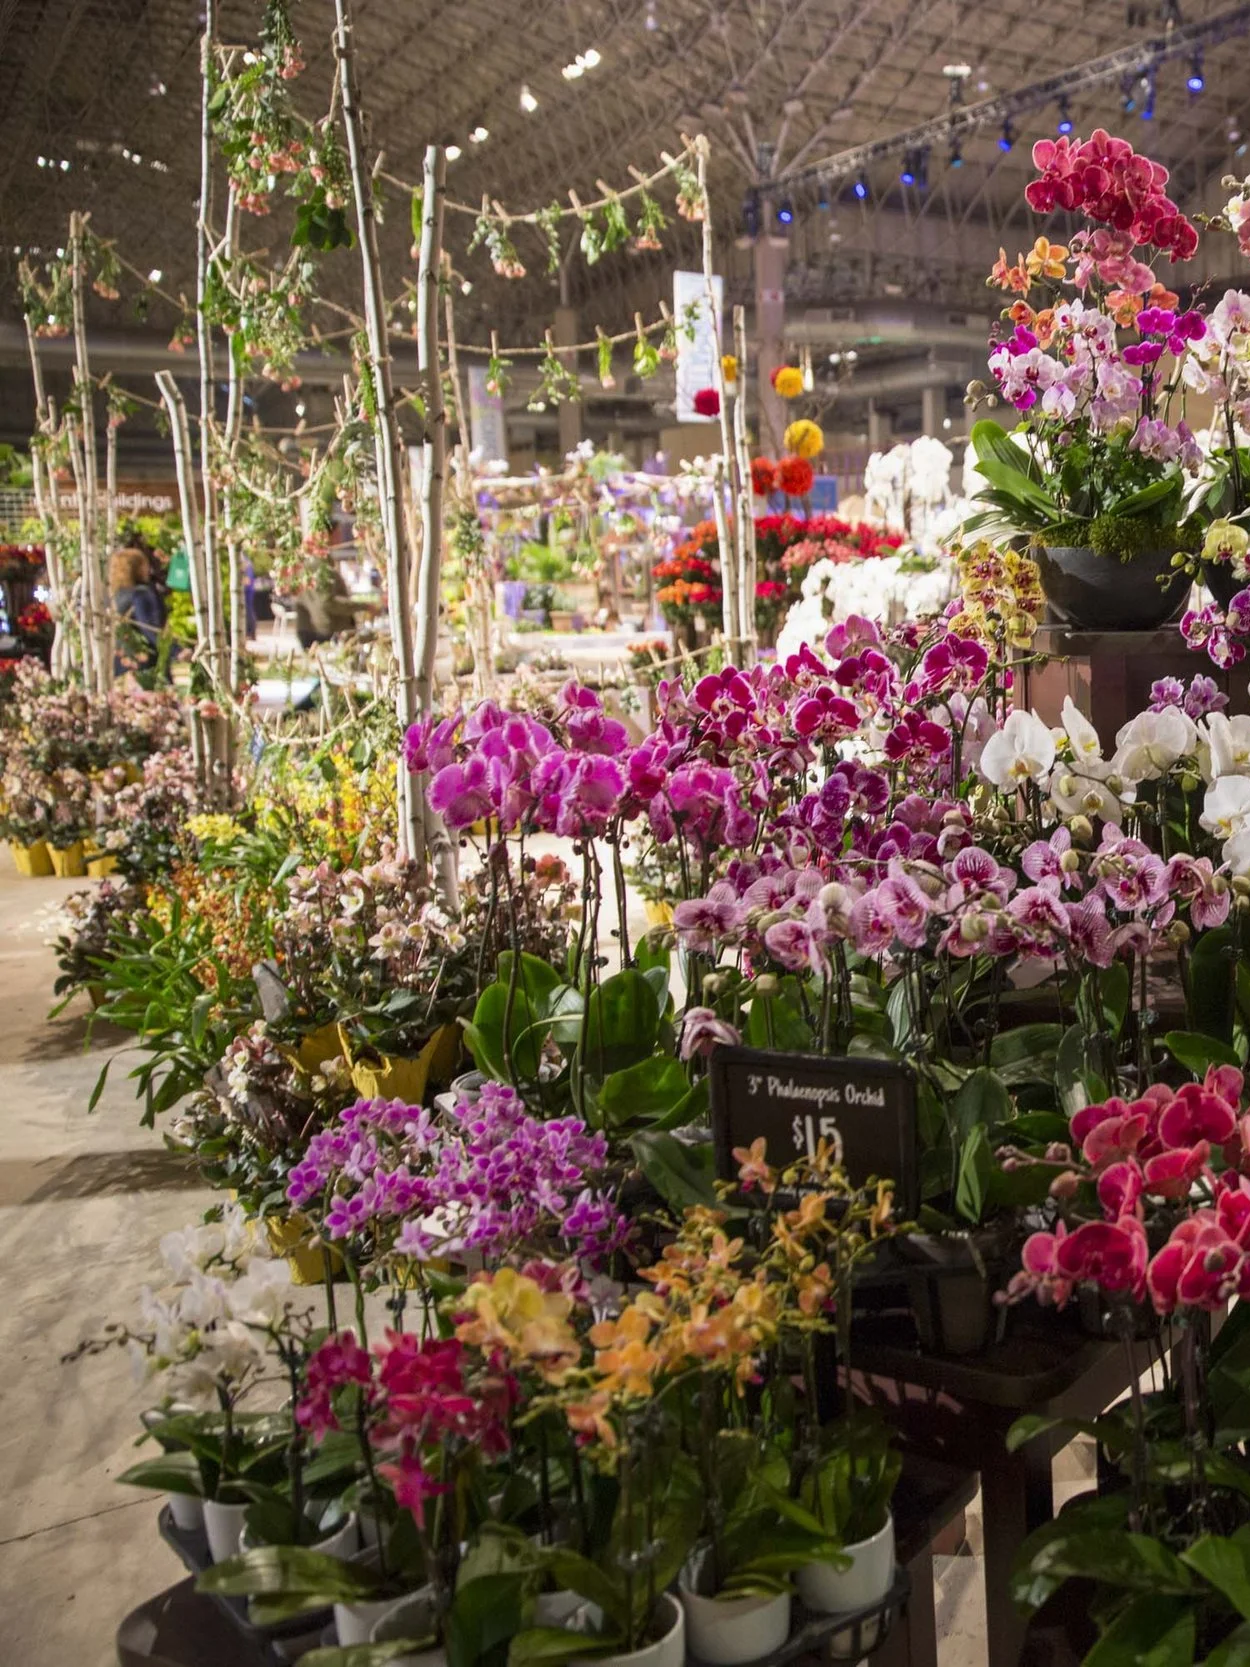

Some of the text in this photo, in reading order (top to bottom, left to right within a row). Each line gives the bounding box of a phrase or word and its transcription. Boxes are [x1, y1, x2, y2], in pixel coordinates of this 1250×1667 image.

[768, 1075, 840, 1109] Phalaenopsis
[845, 1084, 885, 1107] Orchid
[792, 1114, 843, 1168] $15
